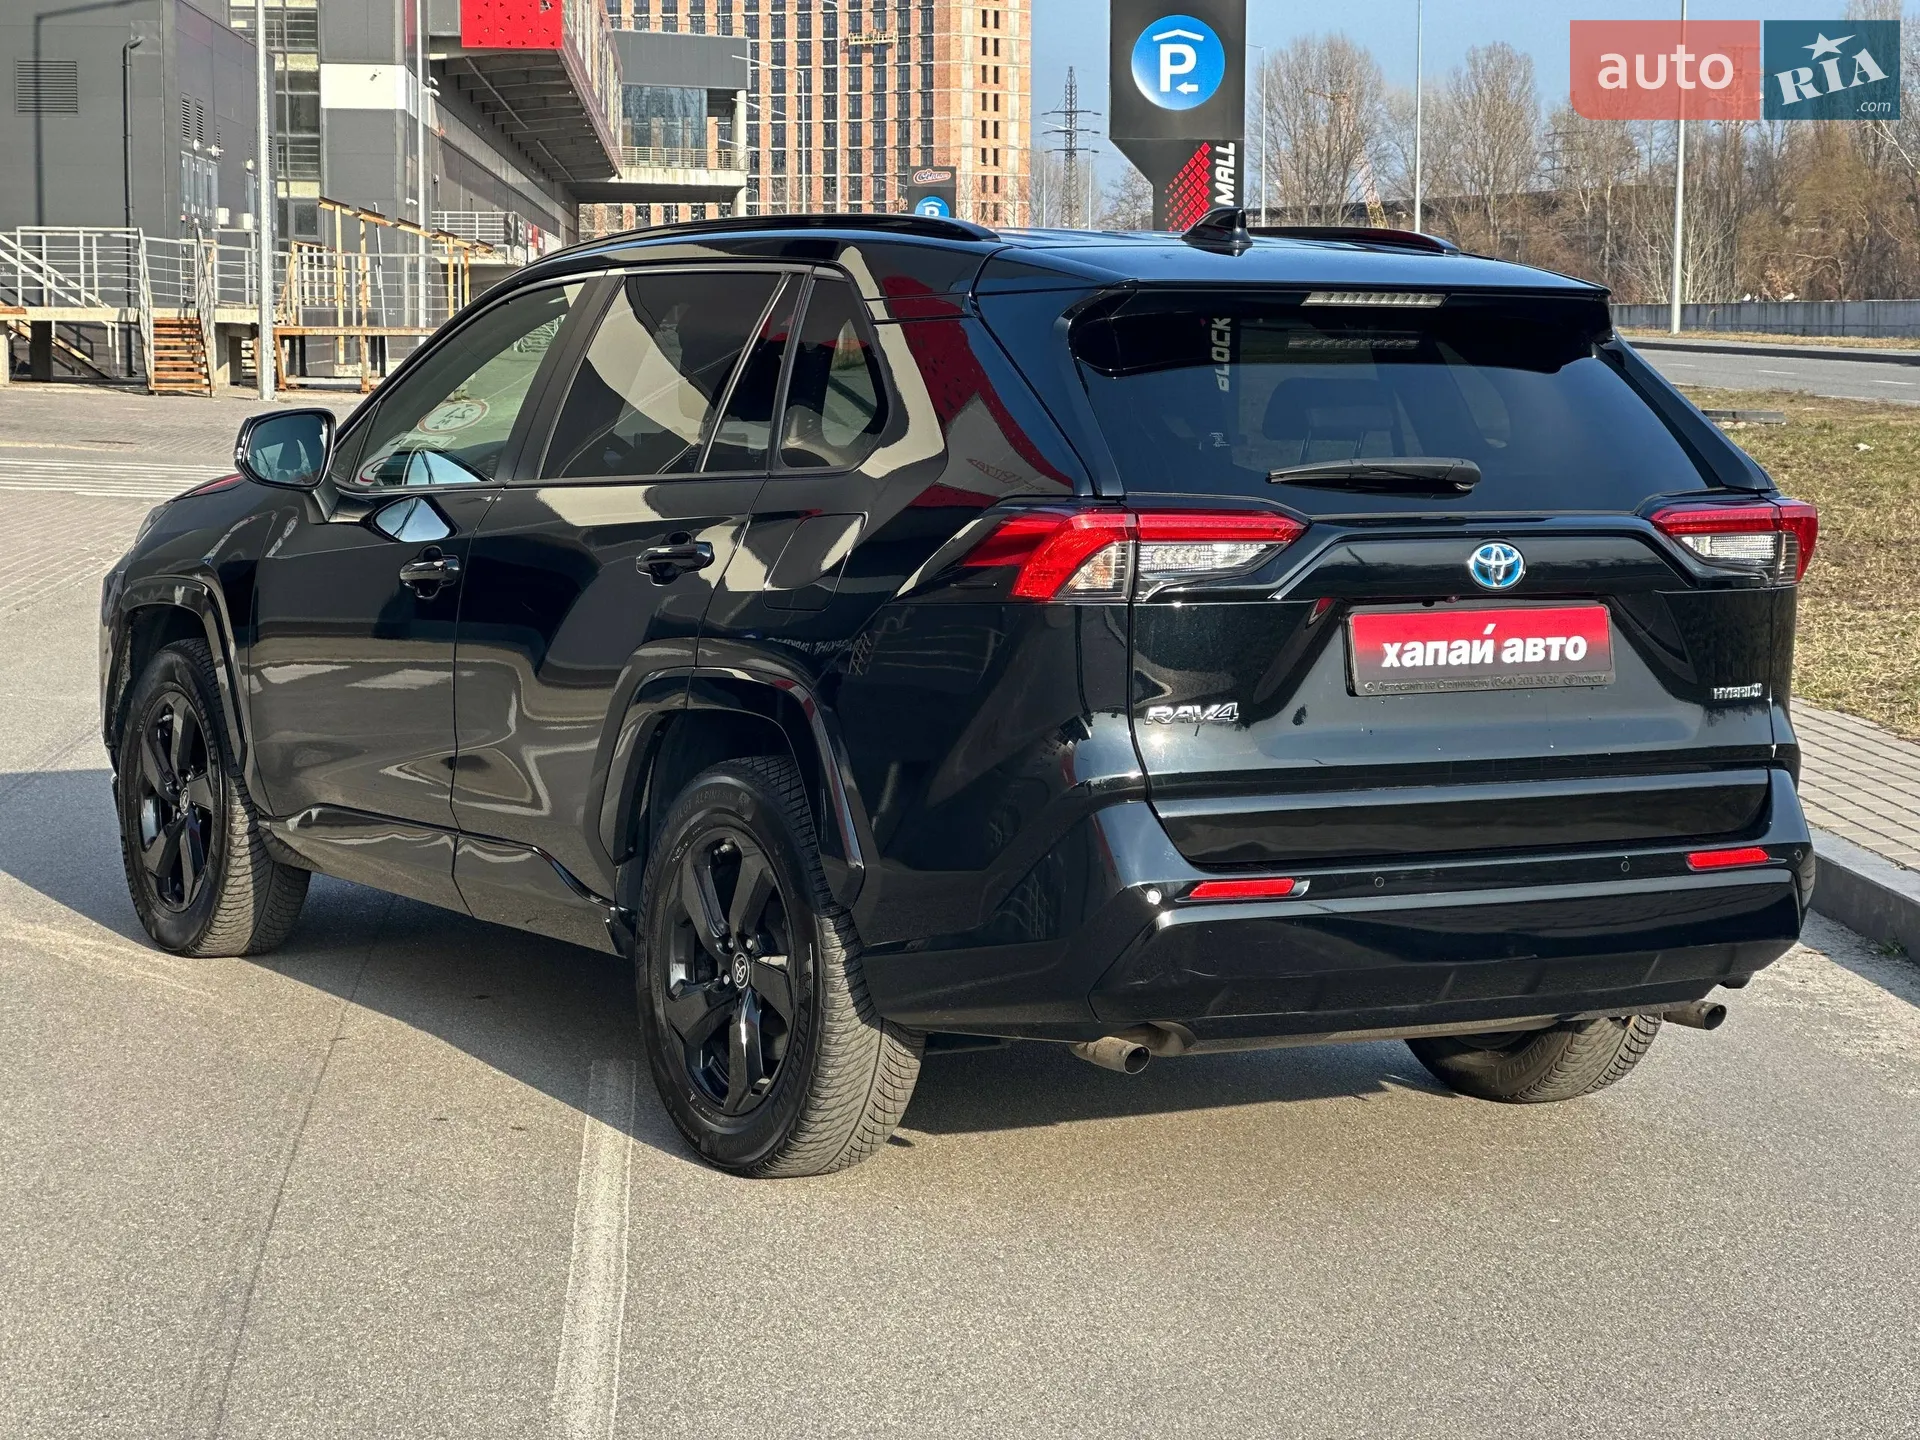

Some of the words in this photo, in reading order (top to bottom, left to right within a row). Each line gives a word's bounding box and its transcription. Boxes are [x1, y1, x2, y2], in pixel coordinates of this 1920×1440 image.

[1159, 43, 1197, 92] P
[1214, 141, 1236, 207] MALL
[1501, 635, 1588, 664] авто
[1518, 674, 1534, 686] 201
[1536, 674, 1547, 685] 30
[1144, 702, 1239, 725] RAV4
